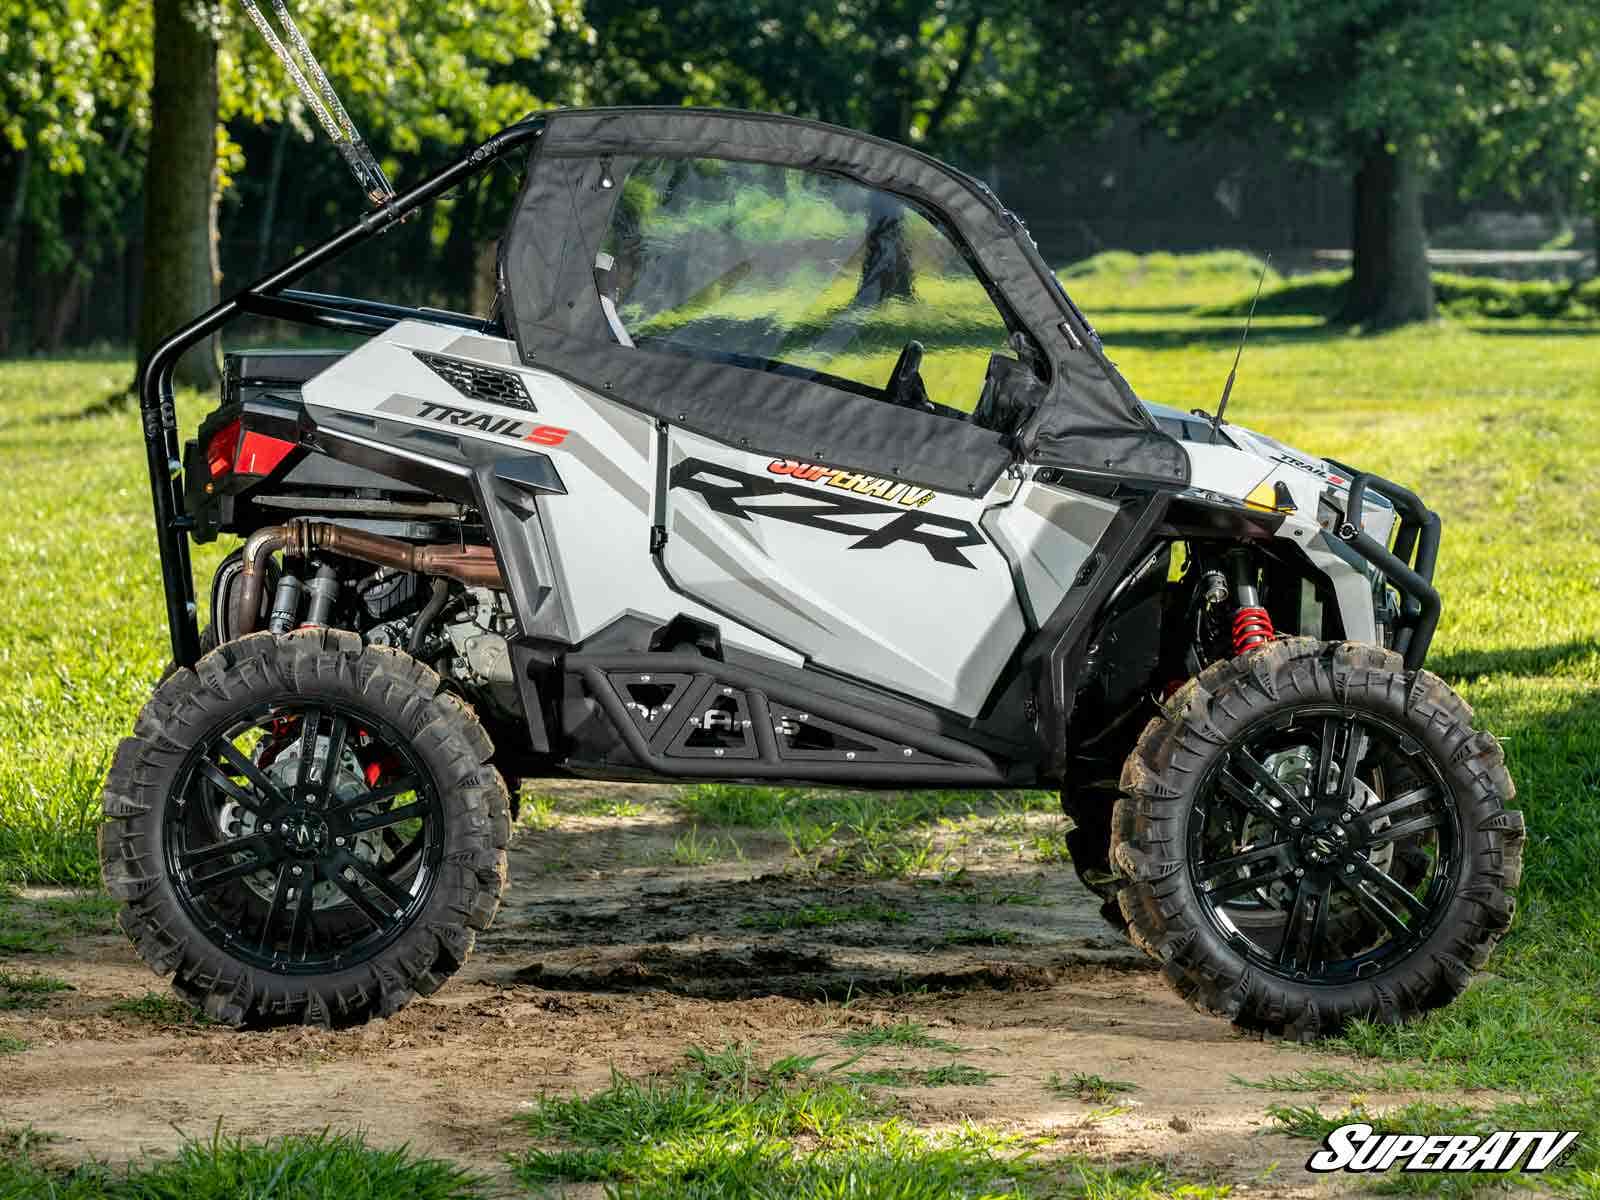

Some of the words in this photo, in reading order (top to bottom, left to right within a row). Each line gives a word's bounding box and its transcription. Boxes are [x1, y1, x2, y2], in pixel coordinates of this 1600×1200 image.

[416, 402, 523, 438] TRAIL
[1281, 455, 1328, 478] TRAIL
[670, 457, 986, 569] RZR
